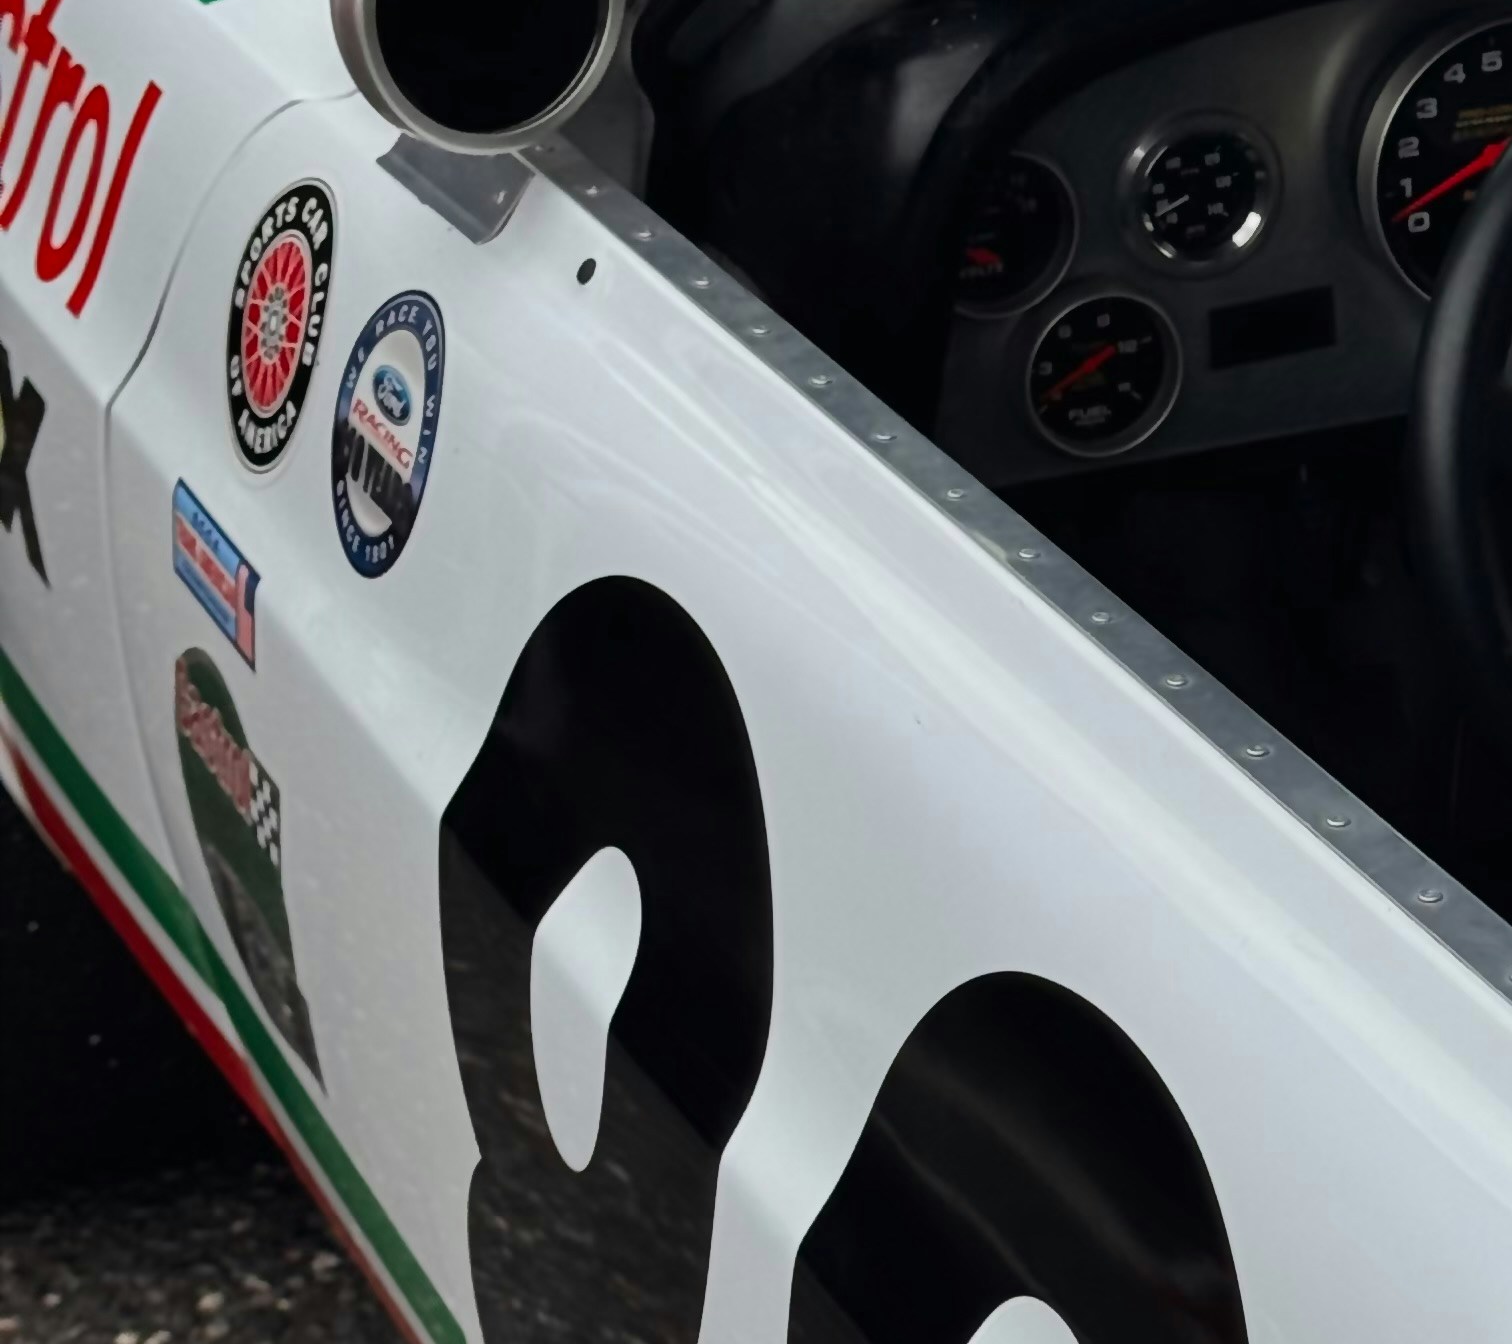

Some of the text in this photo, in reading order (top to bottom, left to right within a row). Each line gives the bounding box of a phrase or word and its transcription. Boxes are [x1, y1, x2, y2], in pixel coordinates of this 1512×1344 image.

[1442, 62, 1467, 84] 4
[1480, 49, 1504, 73] 5
[1415, 96, 1439, 120] 3
[1397, 135, 1421, 160] 2
[1399, 177, 1414, 199] 1
[1407, 210, 1431, 233] 0
[236, 196, 328, 365] SPORTS CAR CLUB
[375, 304, 420, 337] RACE
[421, 317, 438, 372] YOU
[237, 400, 297, 455] AMERICA
[351, 398, 413, 470] RACING
[336, 479, 361, 553] SINCE
